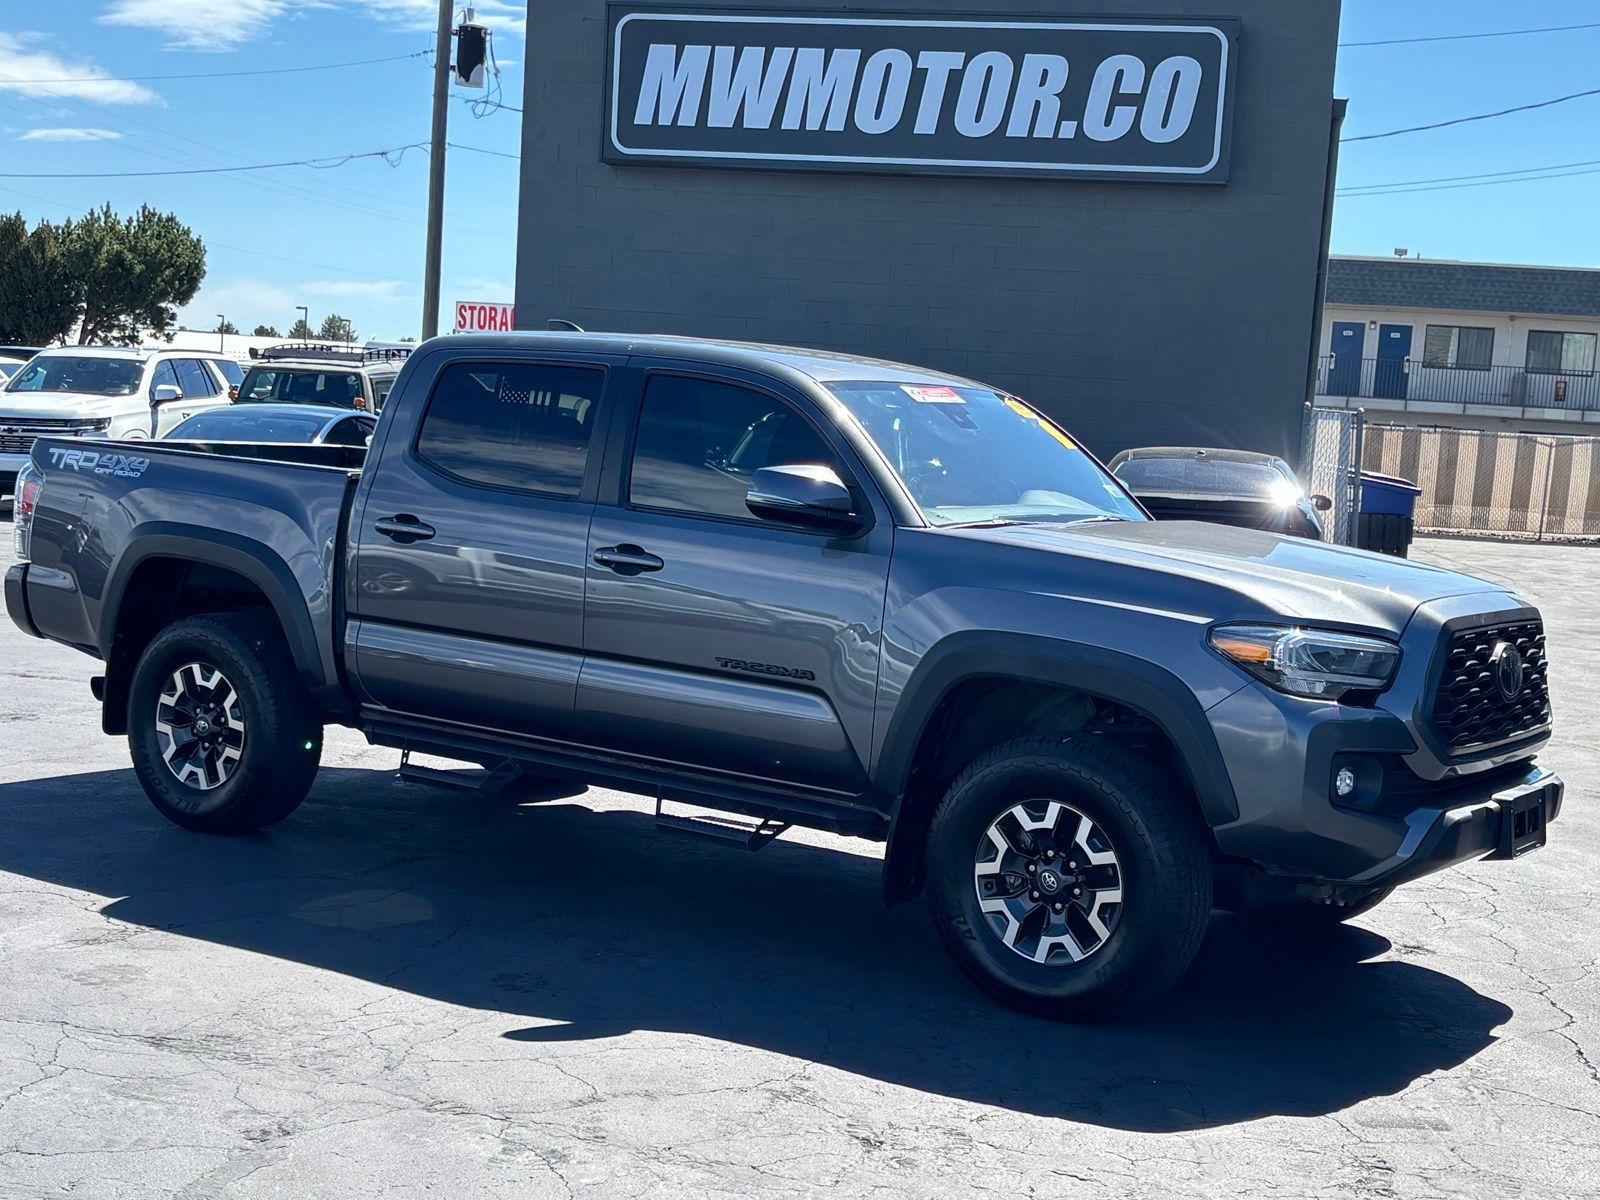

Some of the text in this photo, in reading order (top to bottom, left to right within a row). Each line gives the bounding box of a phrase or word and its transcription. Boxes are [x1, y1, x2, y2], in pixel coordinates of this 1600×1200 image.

[633, 44, 1202, 143] MWMOTOR.CO
[49, 447, 100, 472] TRD
[94, 467, 141, 478] OFF ROAD
[715, 656, 816, 681] TACOMA
